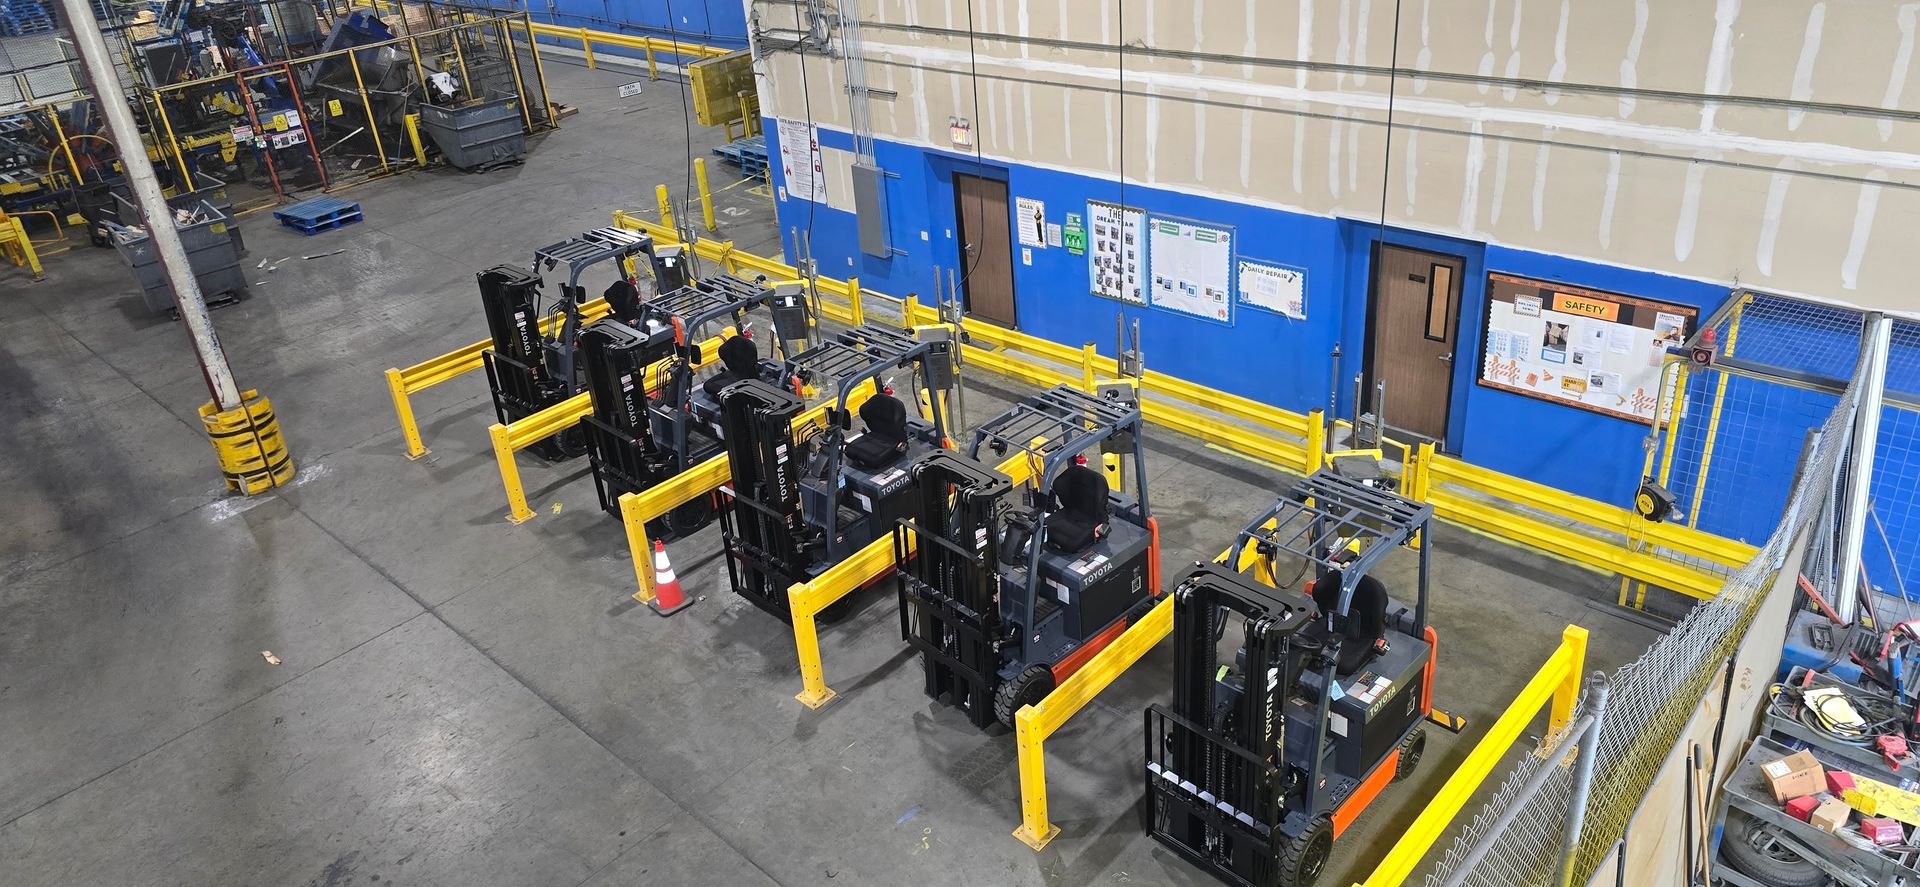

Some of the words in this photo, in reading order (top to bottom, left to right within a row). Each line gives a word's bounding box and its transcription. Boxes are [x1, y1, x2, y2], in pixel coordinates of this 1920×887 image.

[1096, 215, 1115, 224] DREAM
[1117, 220, 1134, 228] TAM
[1109, 208, 1121, 220] THE
[1247, 266, 1264, 275] DAILY
[1265, 270, 1288, 280] REPAIR
[1564, 300, 1605, 315] SAFETY
[519, 325, 532, 356] TOYOTA
[625, 393, 638, 428] TOYOTA
[776, 464, 788, 503] TOYOTA
[881, 475, 910, 496] TOYOTA
[1082, 562, 1113, 586] TOYOTA
[1369, 685, 1396, 717] TOYOTA
[1265, 692, 1274, 742] TOYOTA
